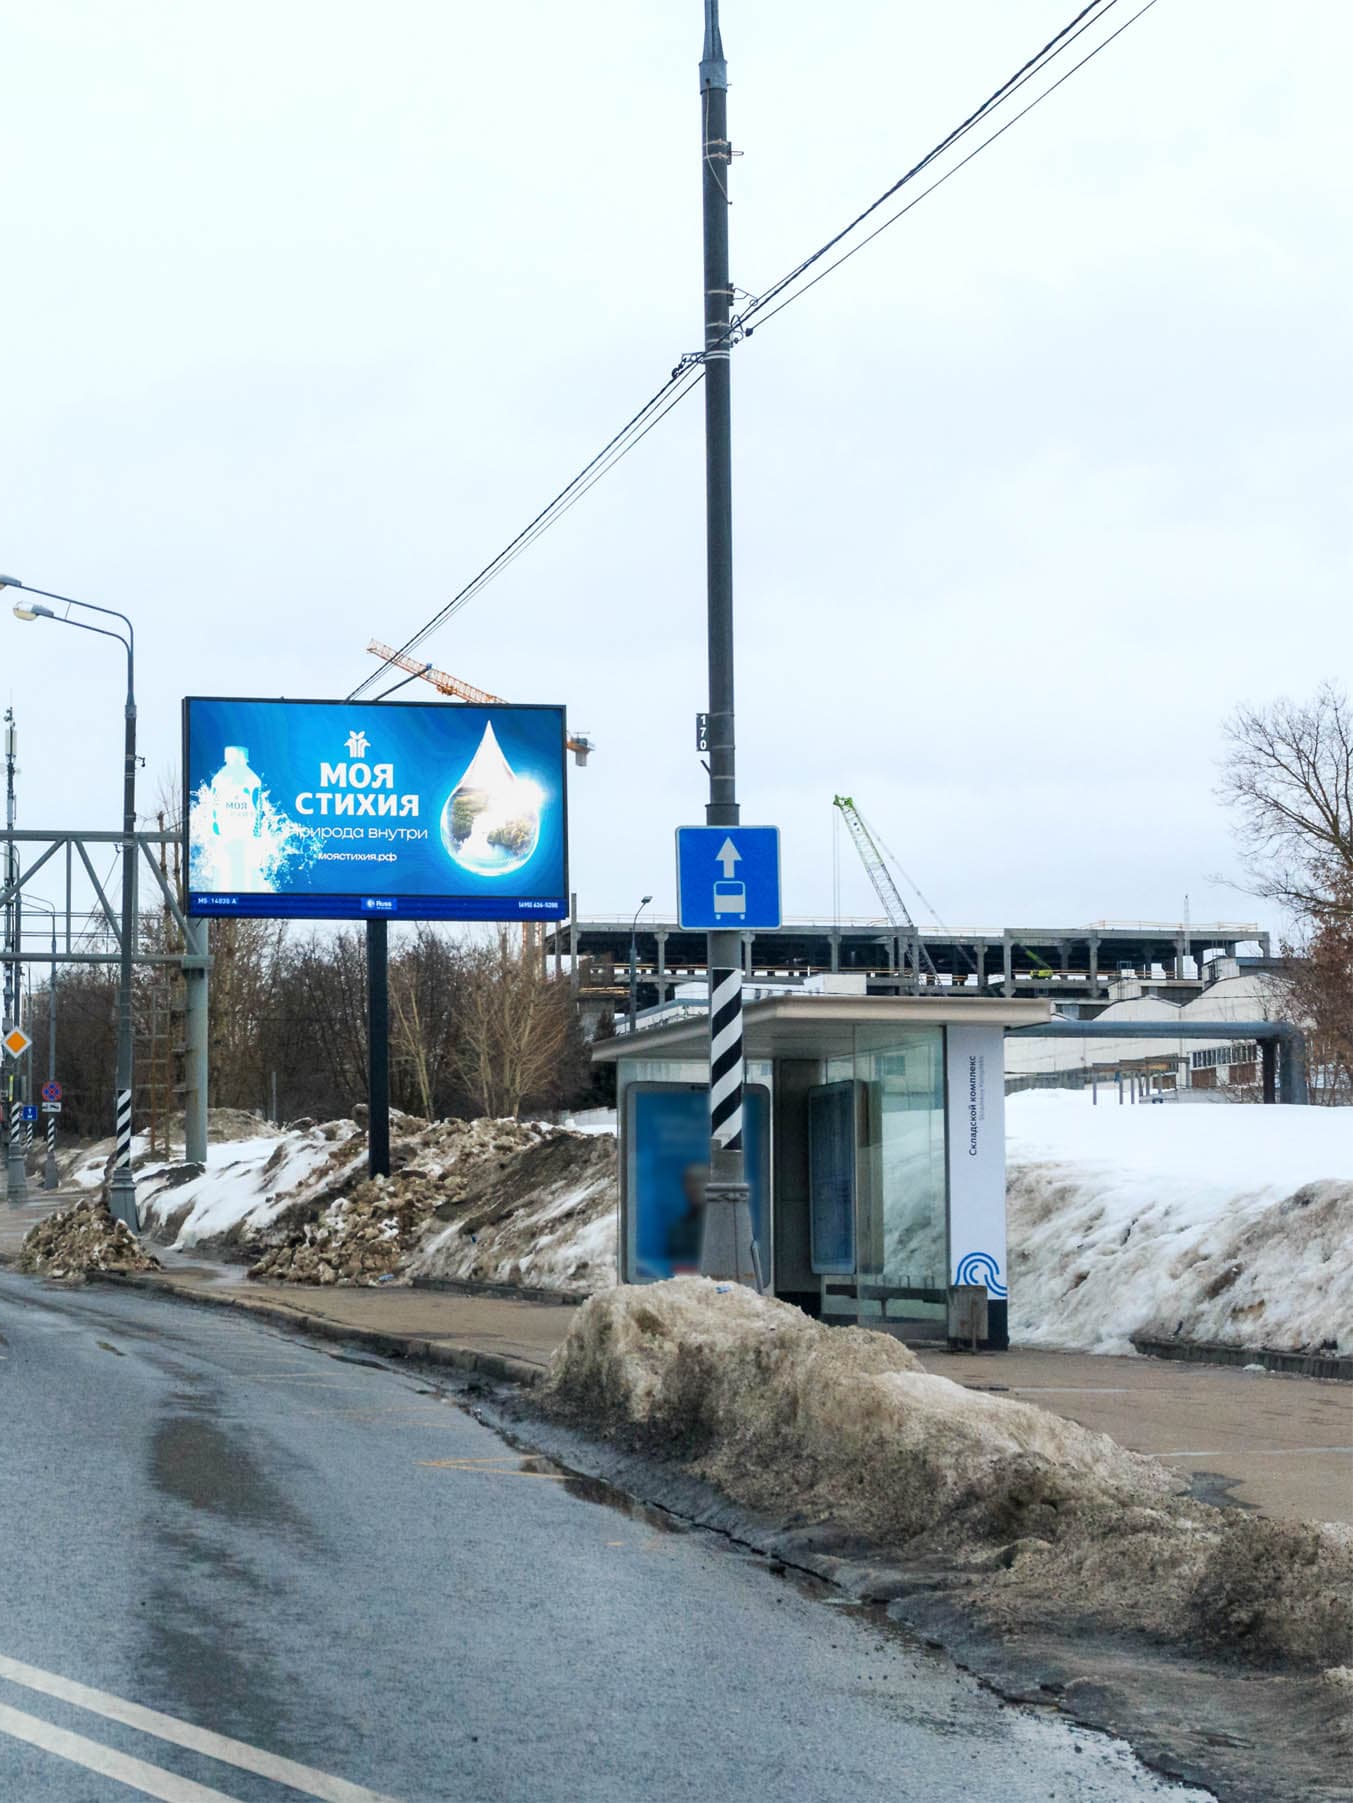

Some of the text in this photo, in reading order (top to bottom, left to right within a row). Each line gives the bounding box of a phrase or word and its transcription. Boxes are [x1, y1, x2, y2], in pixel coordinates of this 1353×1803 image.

[699, 714, 707, 750] 170
[319, 762, 394, 789] МОЯ
[295, 792, 420, 817] СТИХИЯ
[368, 827, 428, 841] внутри
[968, 1055, 977, 1157] Складской комплекс
